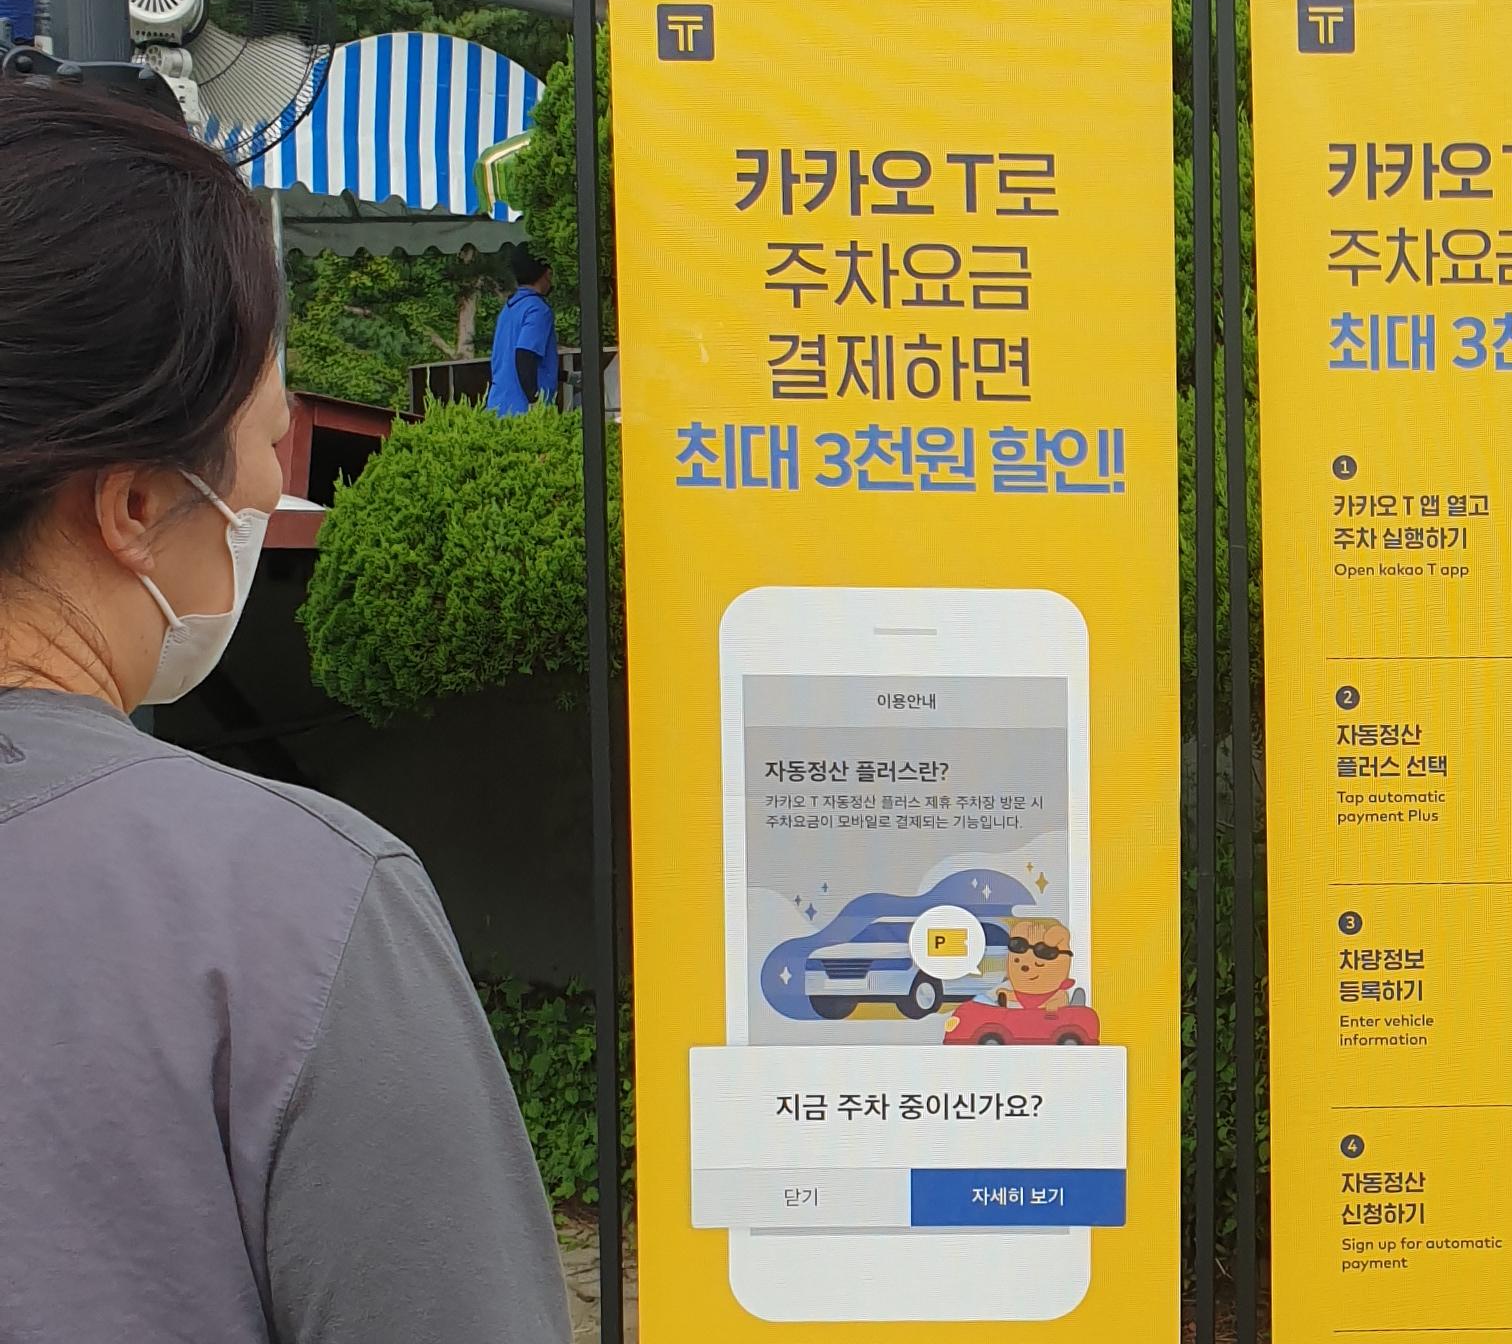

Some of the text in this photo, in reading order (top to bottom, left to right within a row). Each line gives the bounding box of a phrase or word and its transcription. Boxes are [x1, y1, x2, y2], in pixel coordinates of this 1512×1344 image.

[1327, 142, 1492, 200] 카카오
[735, 149, 1059, 217] 카카오 T로
[765, 242, 1031, 310] 주차요금
[1329, 312, 1435, 371] 최대
[767, 334, 1031, 402] 결제하면
[675, 422, 1126, 494] 최대 3천원 할인!
[1334, 495, 1489, 517] 카카오 T 앱 열고
[1333, 527, 1467, 550] 주차 실행하기
[1334, 563, 1469, 579] Open kakao T app
[876, 692, 937, 710] 이용안내
[1337, 725, 1421, 746] 자동정산
[765, 760, 949, 783] 자동정산 플러스란?
[1337, 756, 1448, 777] 플러스 선택
[765, 795, 1044, 810] 카카오 T 자동정산 플러스 제휴 주차장 방문 시
[1337, 790, 1445, 805] Tap automatic
[766, 814, 1023, 829] 주차요금이 모바일로 결제되는 기능입니다.
[1338, 810, 1439, 825] payment Plus
[935, 935, 946, 949] P
[1339, 949, 1424, 971] 차량정보
[1339, 980, 1423, 1002] 등록하기
[1340, 1014, 1434, 1028] Enter vehicle
[1340, 1034, 1427, 1046] information
[776, 1093, 1042, 1122] 지금 주차 중이신가요?
[1341, 1172, 1426, 1194] 자동정산
[784, 1187, 820, 1207] 닫기
[971, 1187, 1065, 1207] 자세히 보기
[1341, 1202, 1424, 1226] 신청하기
[1342, 1236, 1502, 1252] Sign up for automatic
[1342, 1257, 1408, 1272] payment
